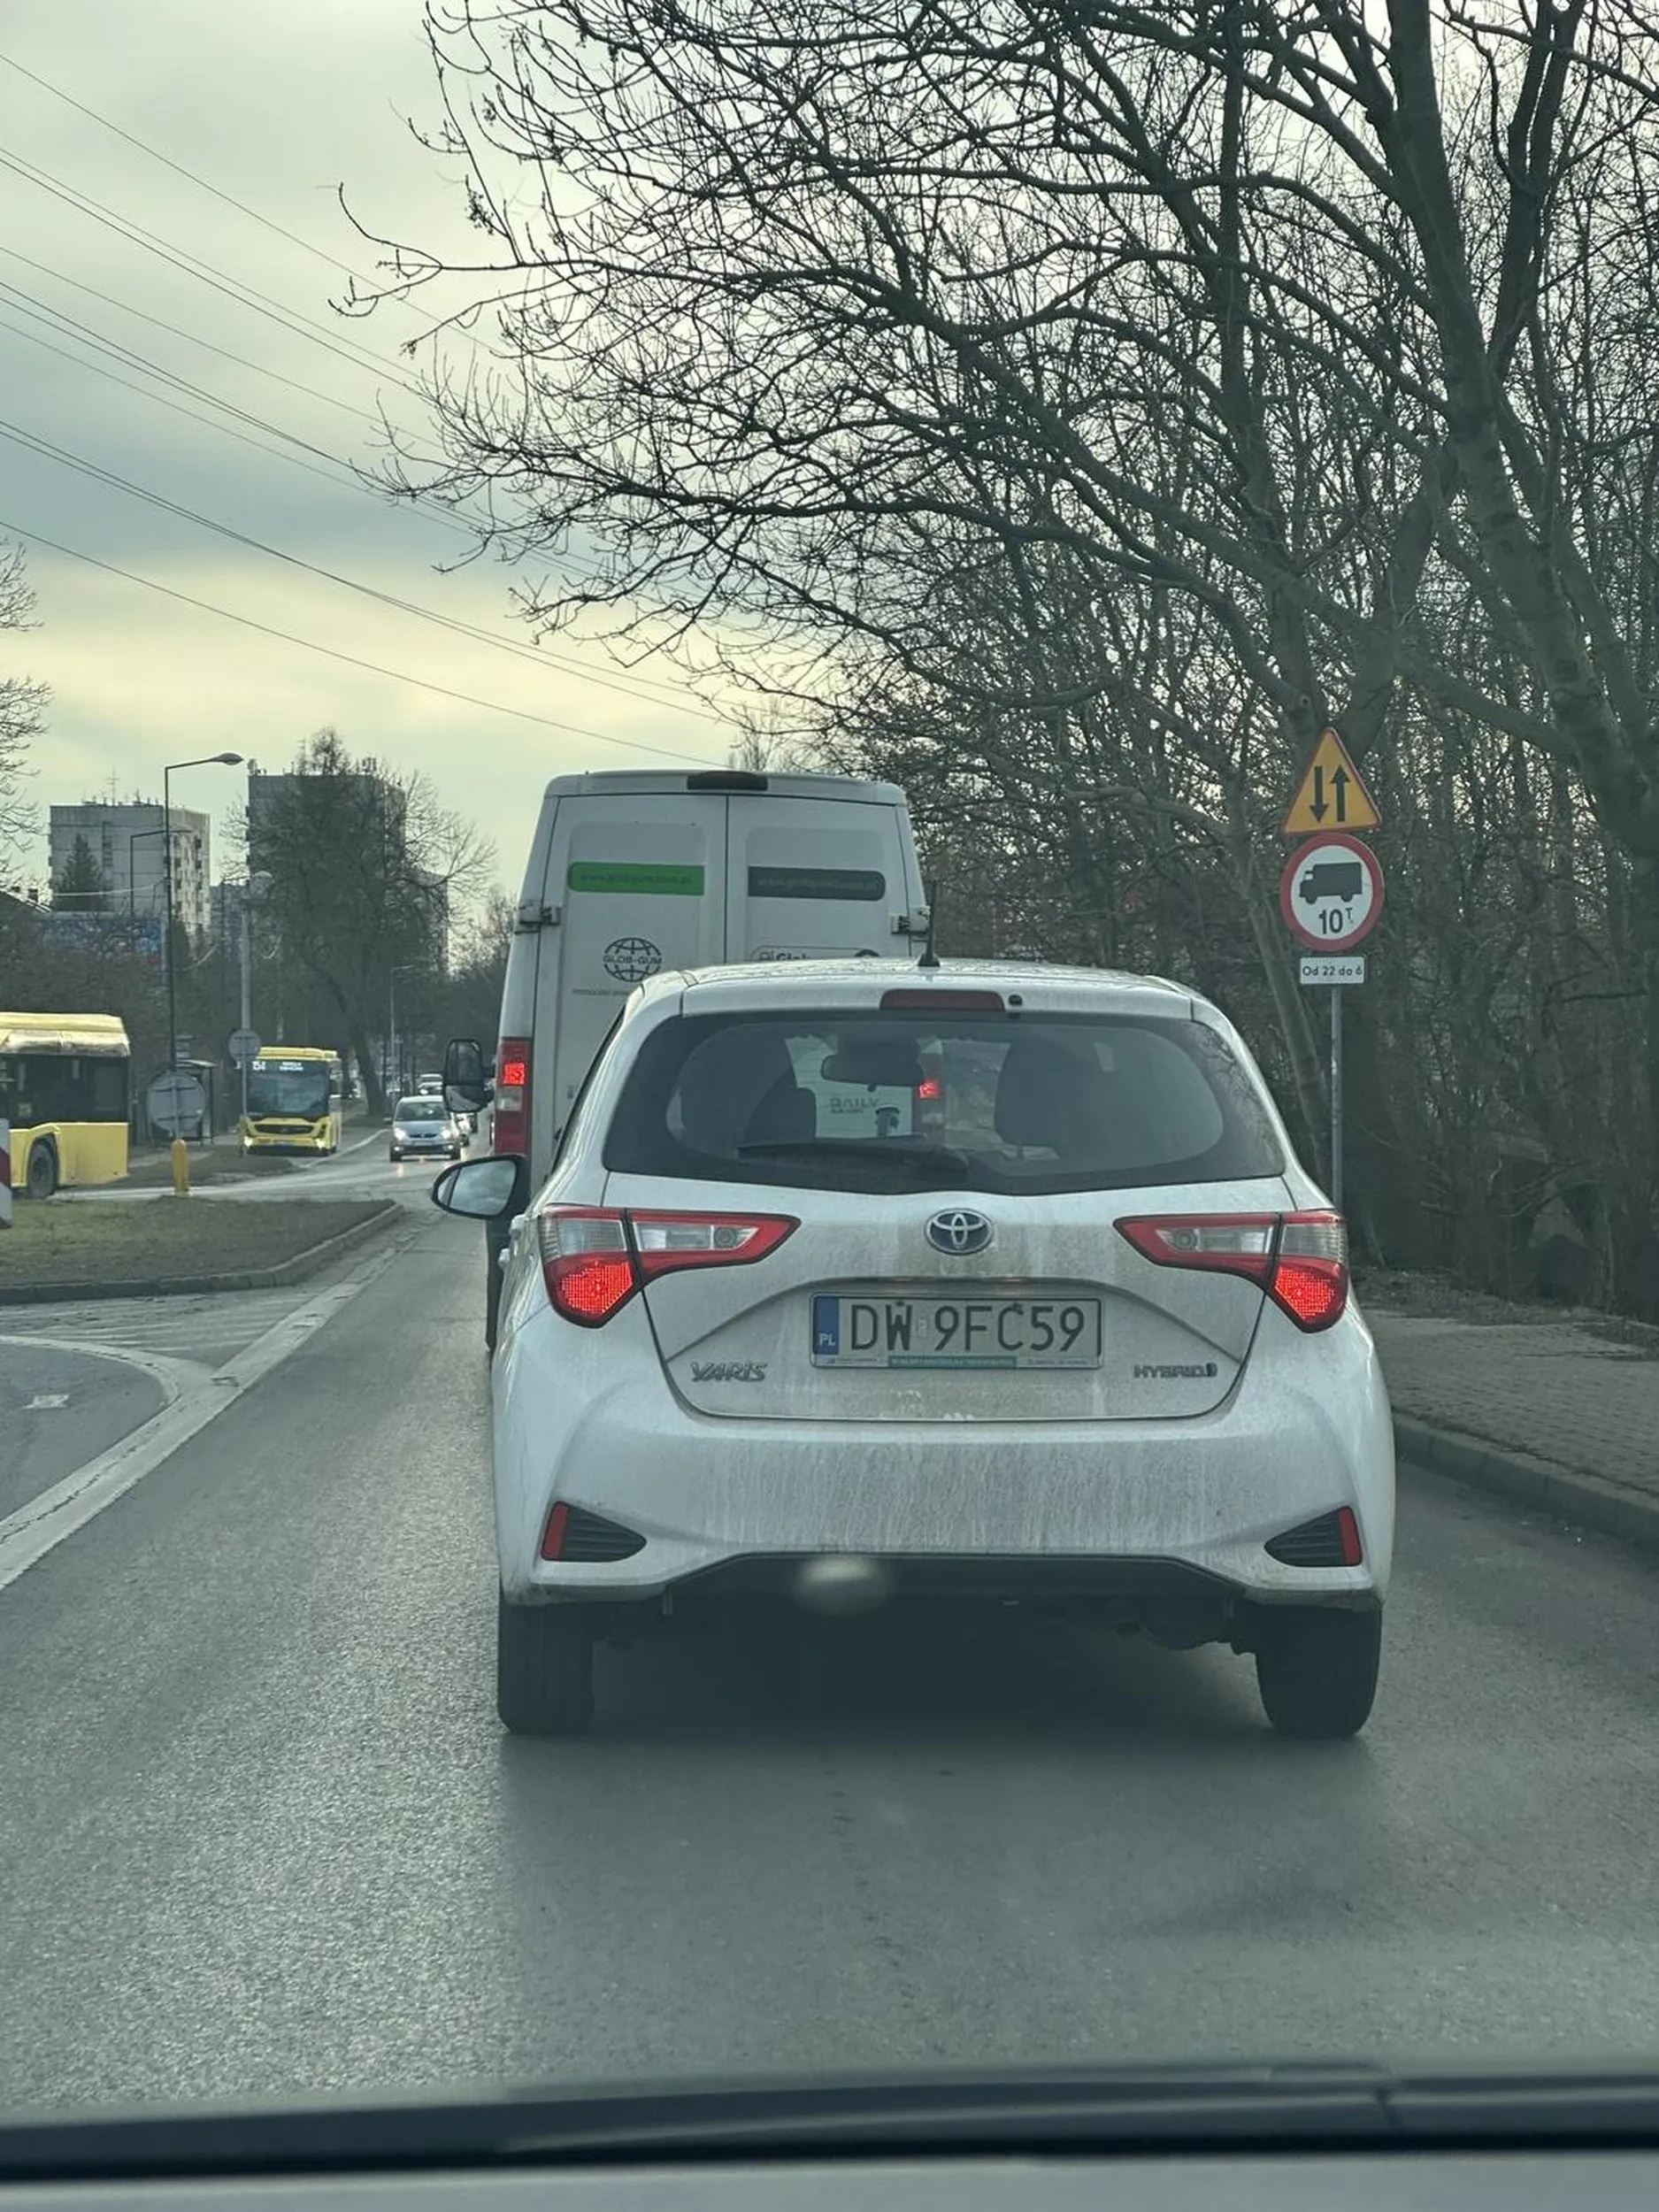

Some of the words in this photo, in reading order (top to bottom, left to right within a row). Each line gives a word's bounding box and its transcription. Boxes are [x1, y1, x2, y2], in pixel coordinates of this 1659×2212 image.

[603, 955, 663, 965] GLOB-GUM
[1302, 965, 1319, 976] Od
[1322, 965, 1336, 977] 22
[1339, 965, 1353, 976] do
[1356, 964, 1363, 976] 6
[851, 1303, 913, 1352] DW
[934, 1304, 1085, 1353] 9FC59
[818, 1333, 836, 1347] PL
[690, 1362, 768, 1381] YARIS
[1133, 1363, 1205, 1378] HYBRID
